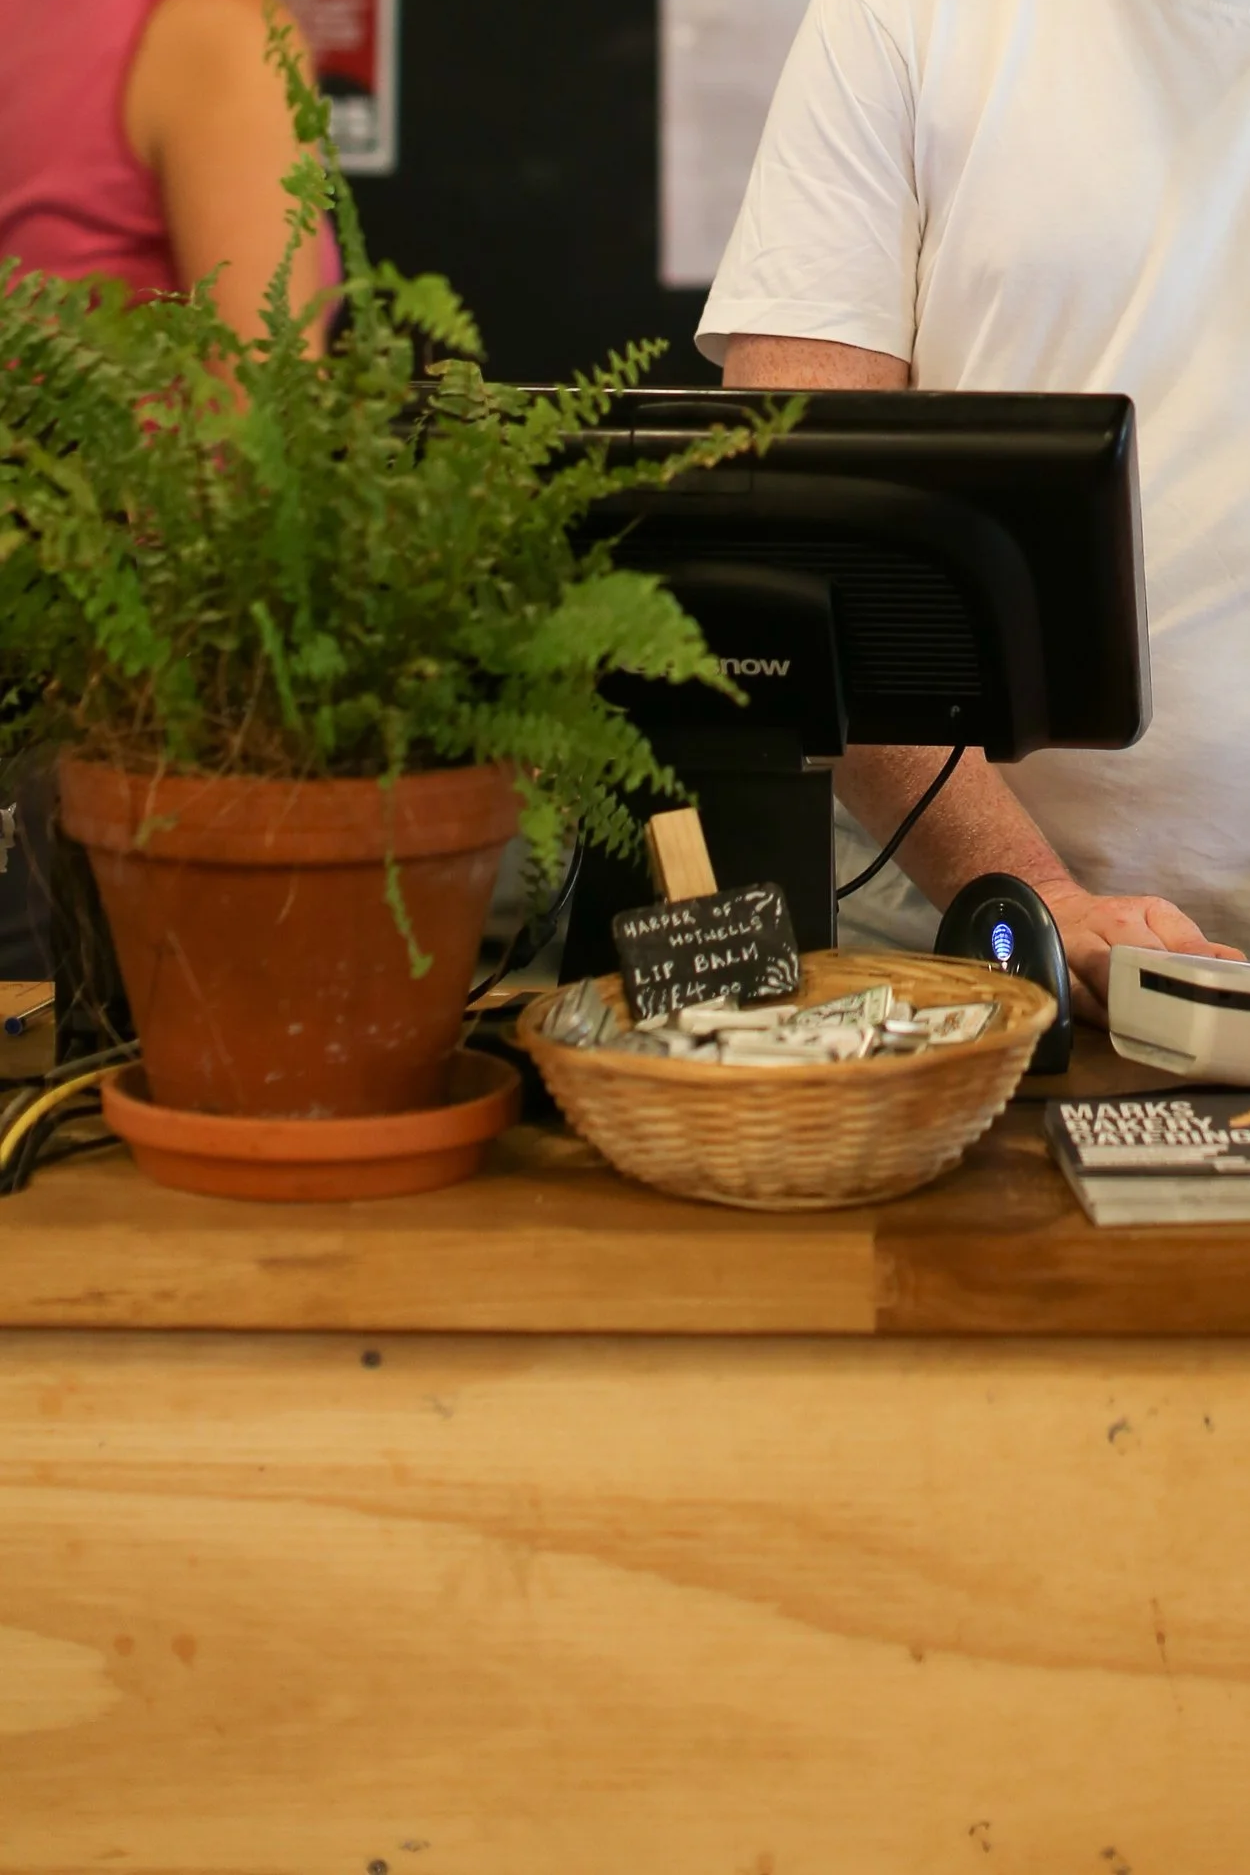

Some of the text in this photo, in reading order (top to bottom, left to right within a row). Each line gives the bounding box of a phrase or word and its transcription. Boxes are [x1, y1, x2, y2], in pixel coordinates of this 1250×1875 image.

[624, 902, 732, 938] HARPER OF
[634, 942, 759, 986] LIP BALM
[1060, 1101, 1195, 1121] MARKS
[1064, 1116, 1213, 1133] BAKERY
